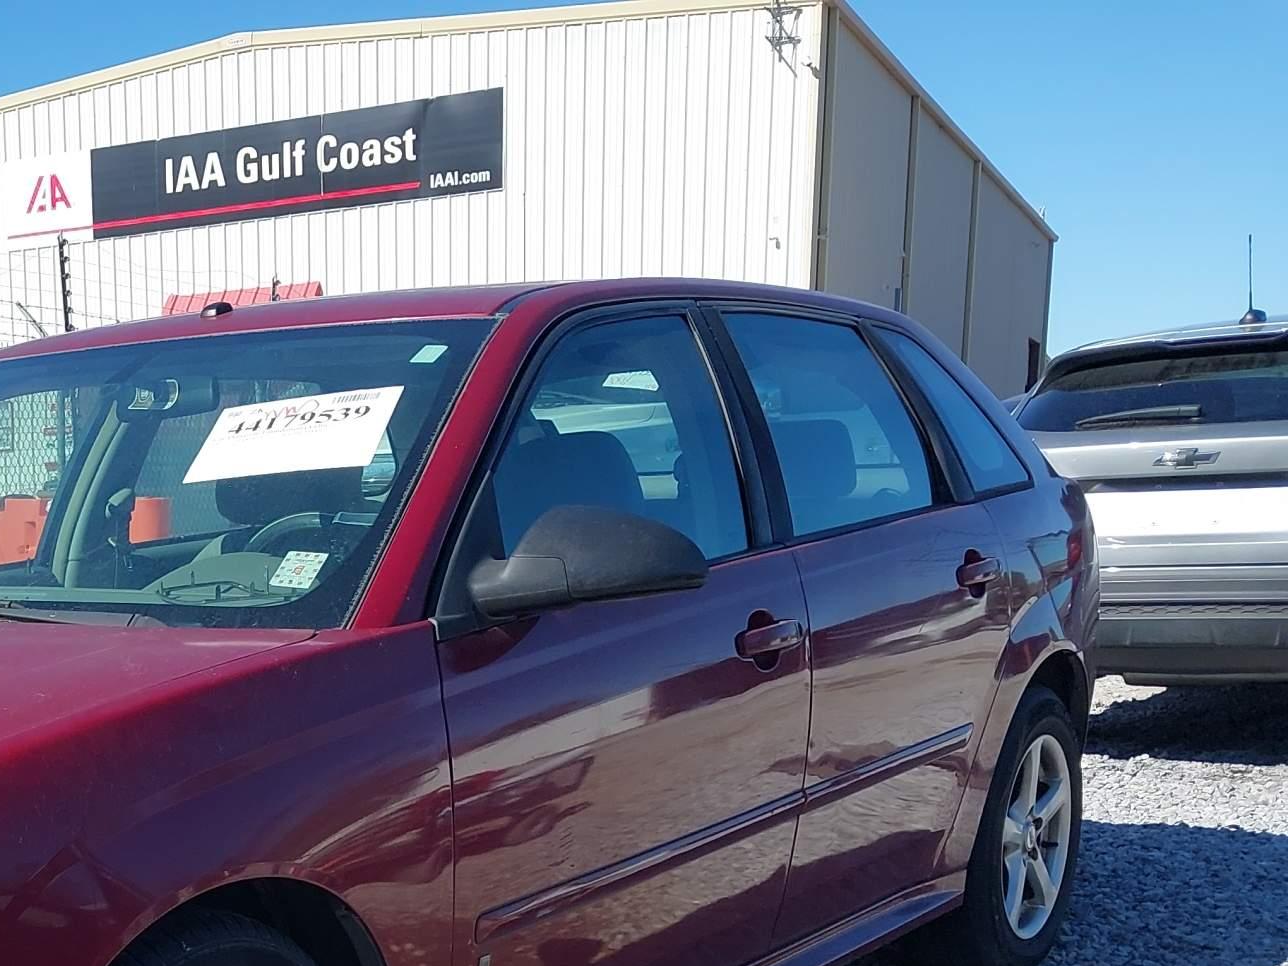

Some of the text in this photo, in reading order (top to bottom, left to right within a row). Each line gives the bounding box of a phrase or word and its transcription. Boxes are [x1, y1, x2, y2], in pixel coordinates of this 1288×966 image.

[165, 128, 417, 194] IAA Gulf Coast
[228, 405, 371, 434] 44179539
